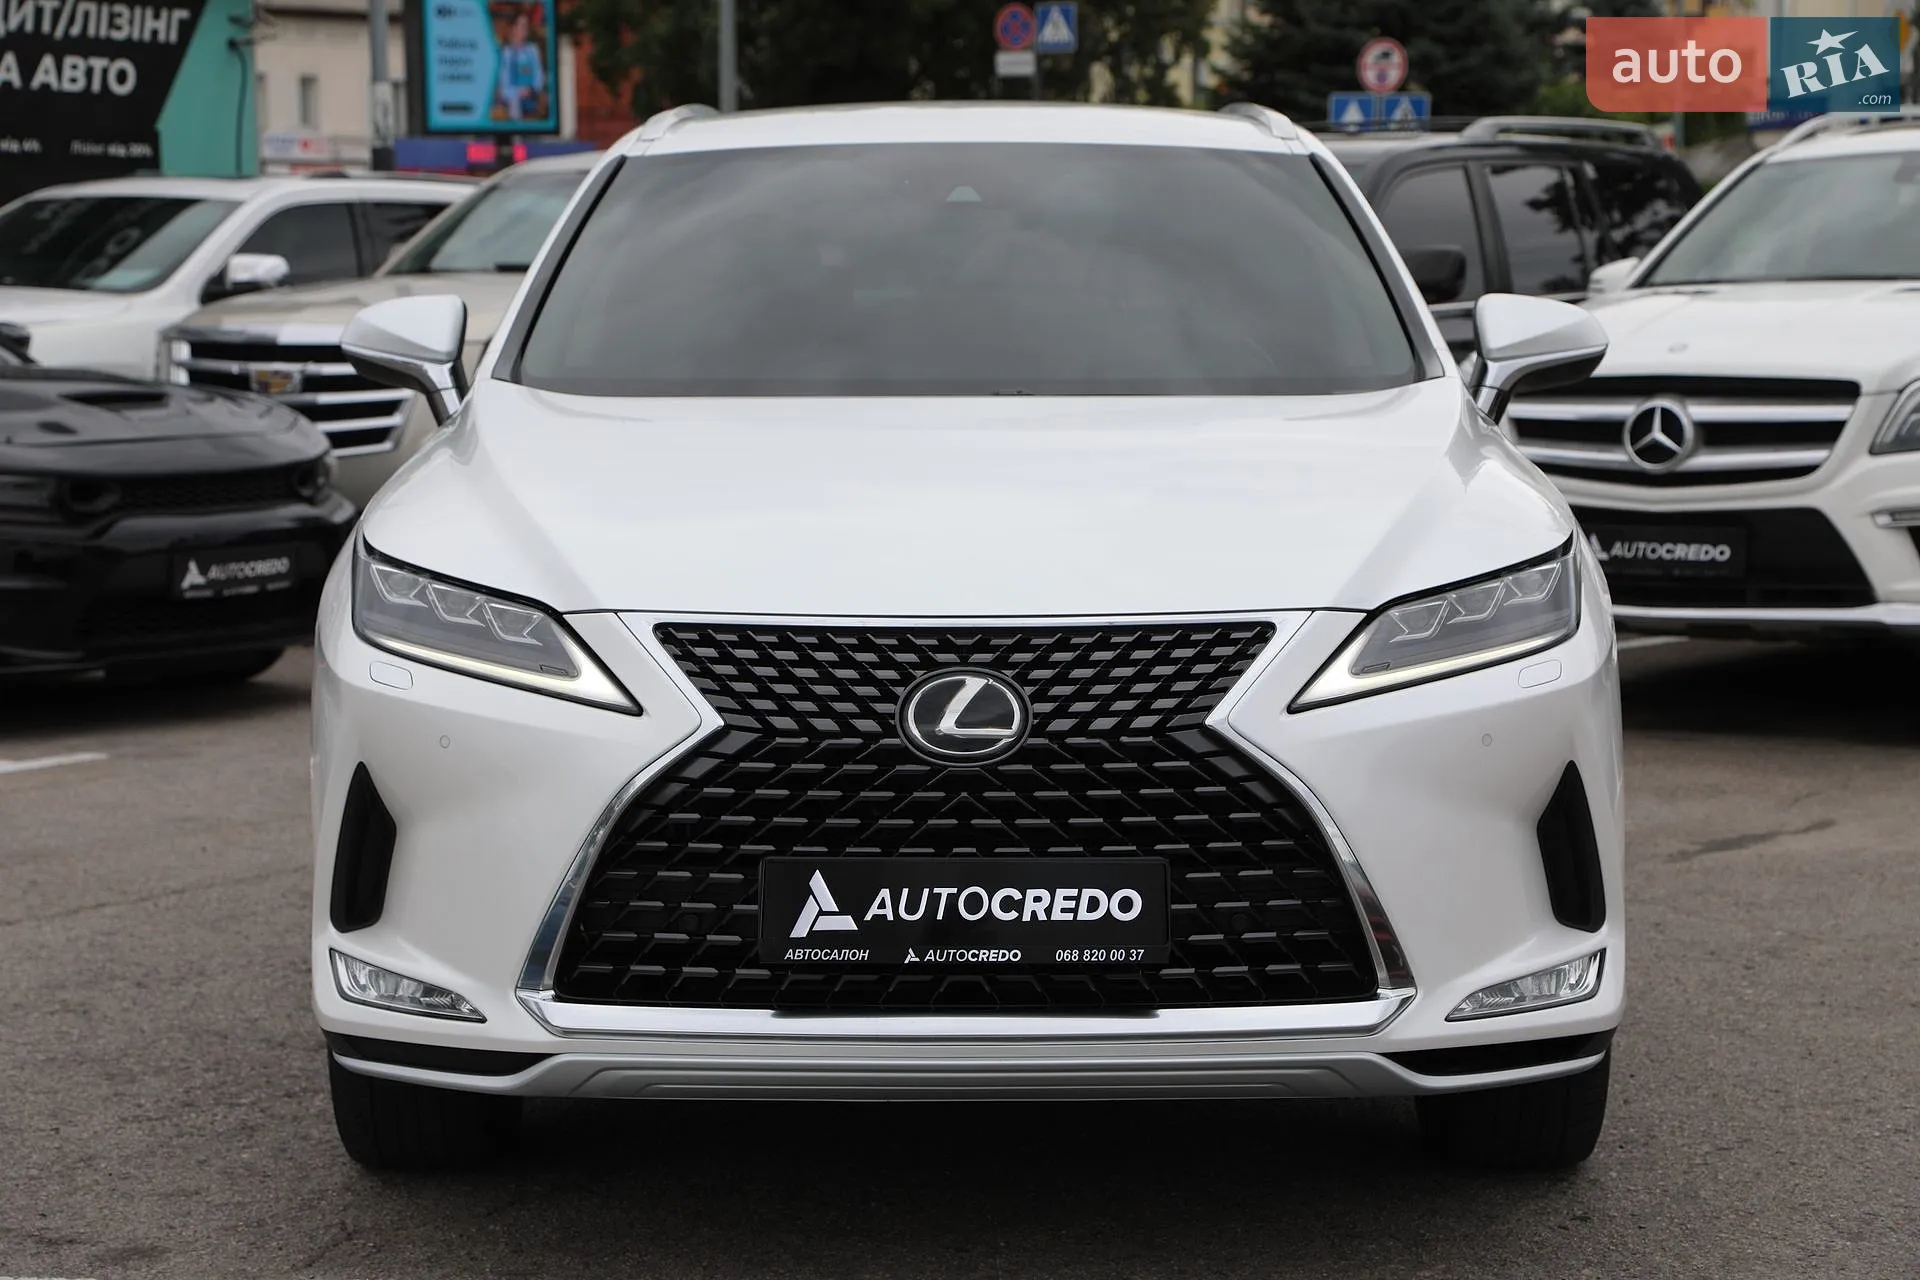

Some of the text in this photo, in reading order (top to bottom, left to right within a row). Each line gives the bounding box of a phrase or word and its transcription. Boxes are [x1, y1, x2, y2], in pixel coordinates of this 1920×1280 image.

[0, 0, 191, 44] ИТ/ЛІЗІНГ
[30, 53, 138, 96] АВТО
[1611, 540, 1732, 562] AUTOCREDO
[207, 556, 291, 580] AUTOCREDO
[863, 885, 1143, 923] AUTOCREDO
[783, 948, 870, 962] АВТОСАЛОН
[923, 948, 1022, 963] AUTOCREDO
[1055, 948, 1145, 962] 068 820 00 37
